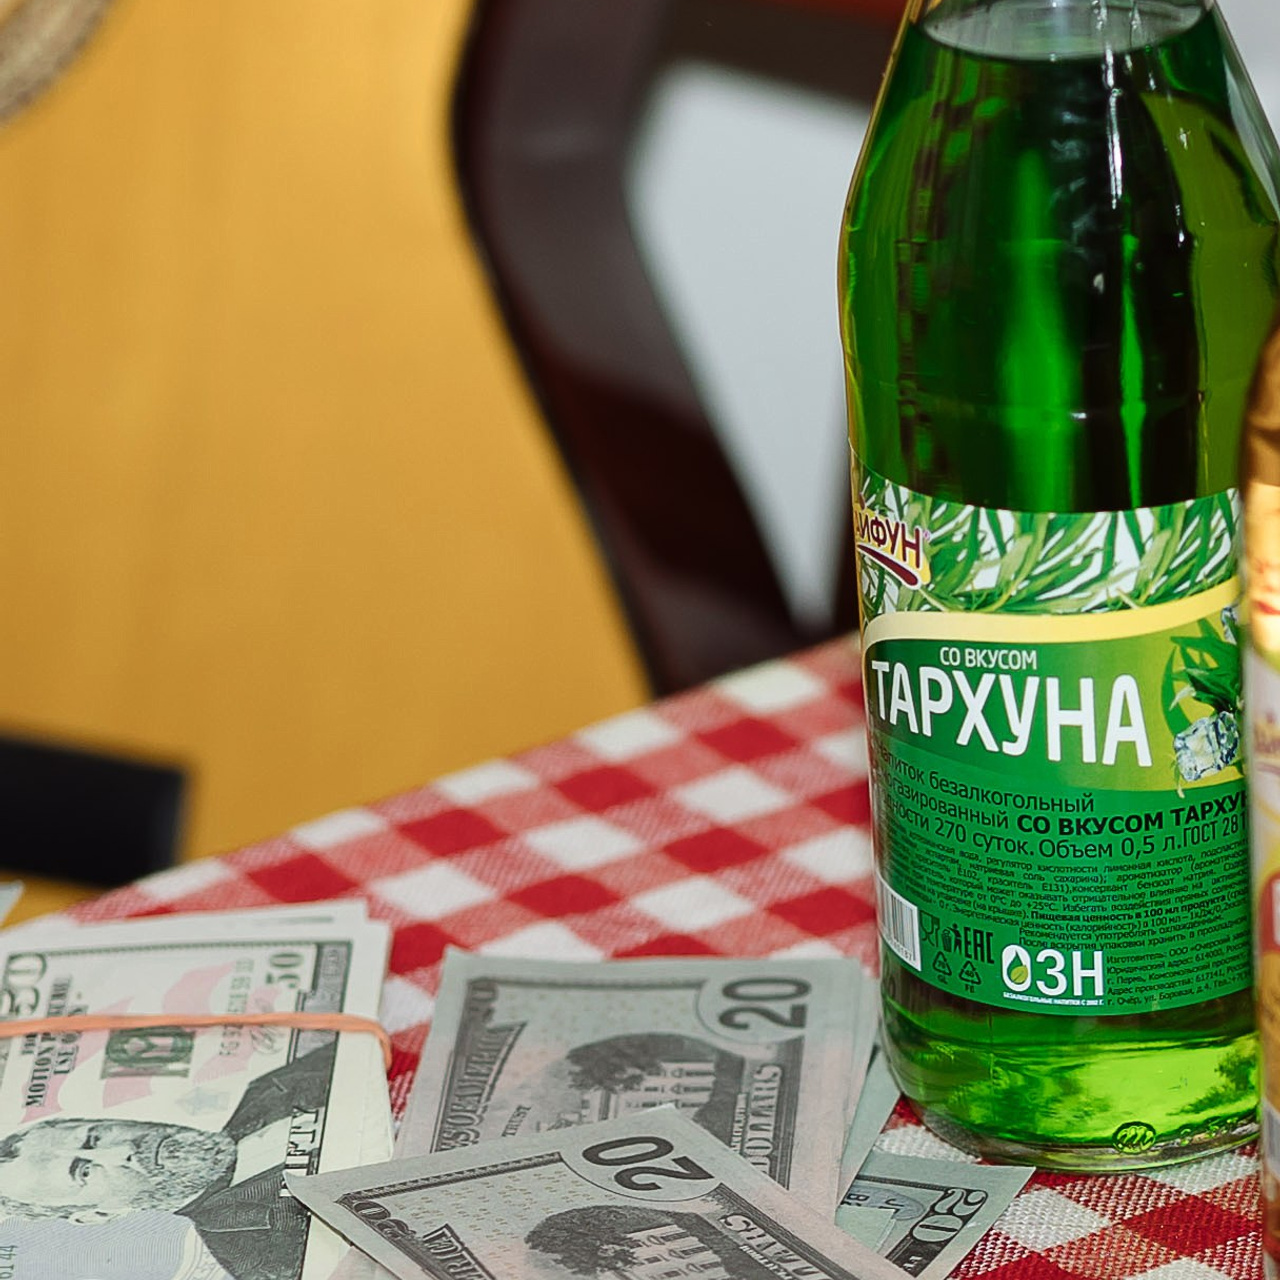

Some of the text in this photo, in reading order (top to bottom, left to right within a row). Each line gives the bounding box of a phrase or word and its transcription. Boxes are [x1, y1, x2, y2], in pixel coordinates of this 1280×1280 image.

[940, 646, 1037, 671] СО ВКУСОМ
[871, 660, 1152, 768] ТАРХУНА
[929, 771, 1094, 812] безалкогольный
[935, 816, 967, 843] 270
[973, 831, 1034, 856] суток.
[1039, 838, 1113, 860] Объем
[1121, 835, 1155, 860] 0,5
[1017, 814, 1050, 835] СО
[1058, 810, 1163, 836] ВКУСОМ
[265, 951, 305, 989] 50
[717, 976, 812, 1031] 20
[581, 1135, 716, 1193] 20
[912, 1187, 989, 1242] 20
